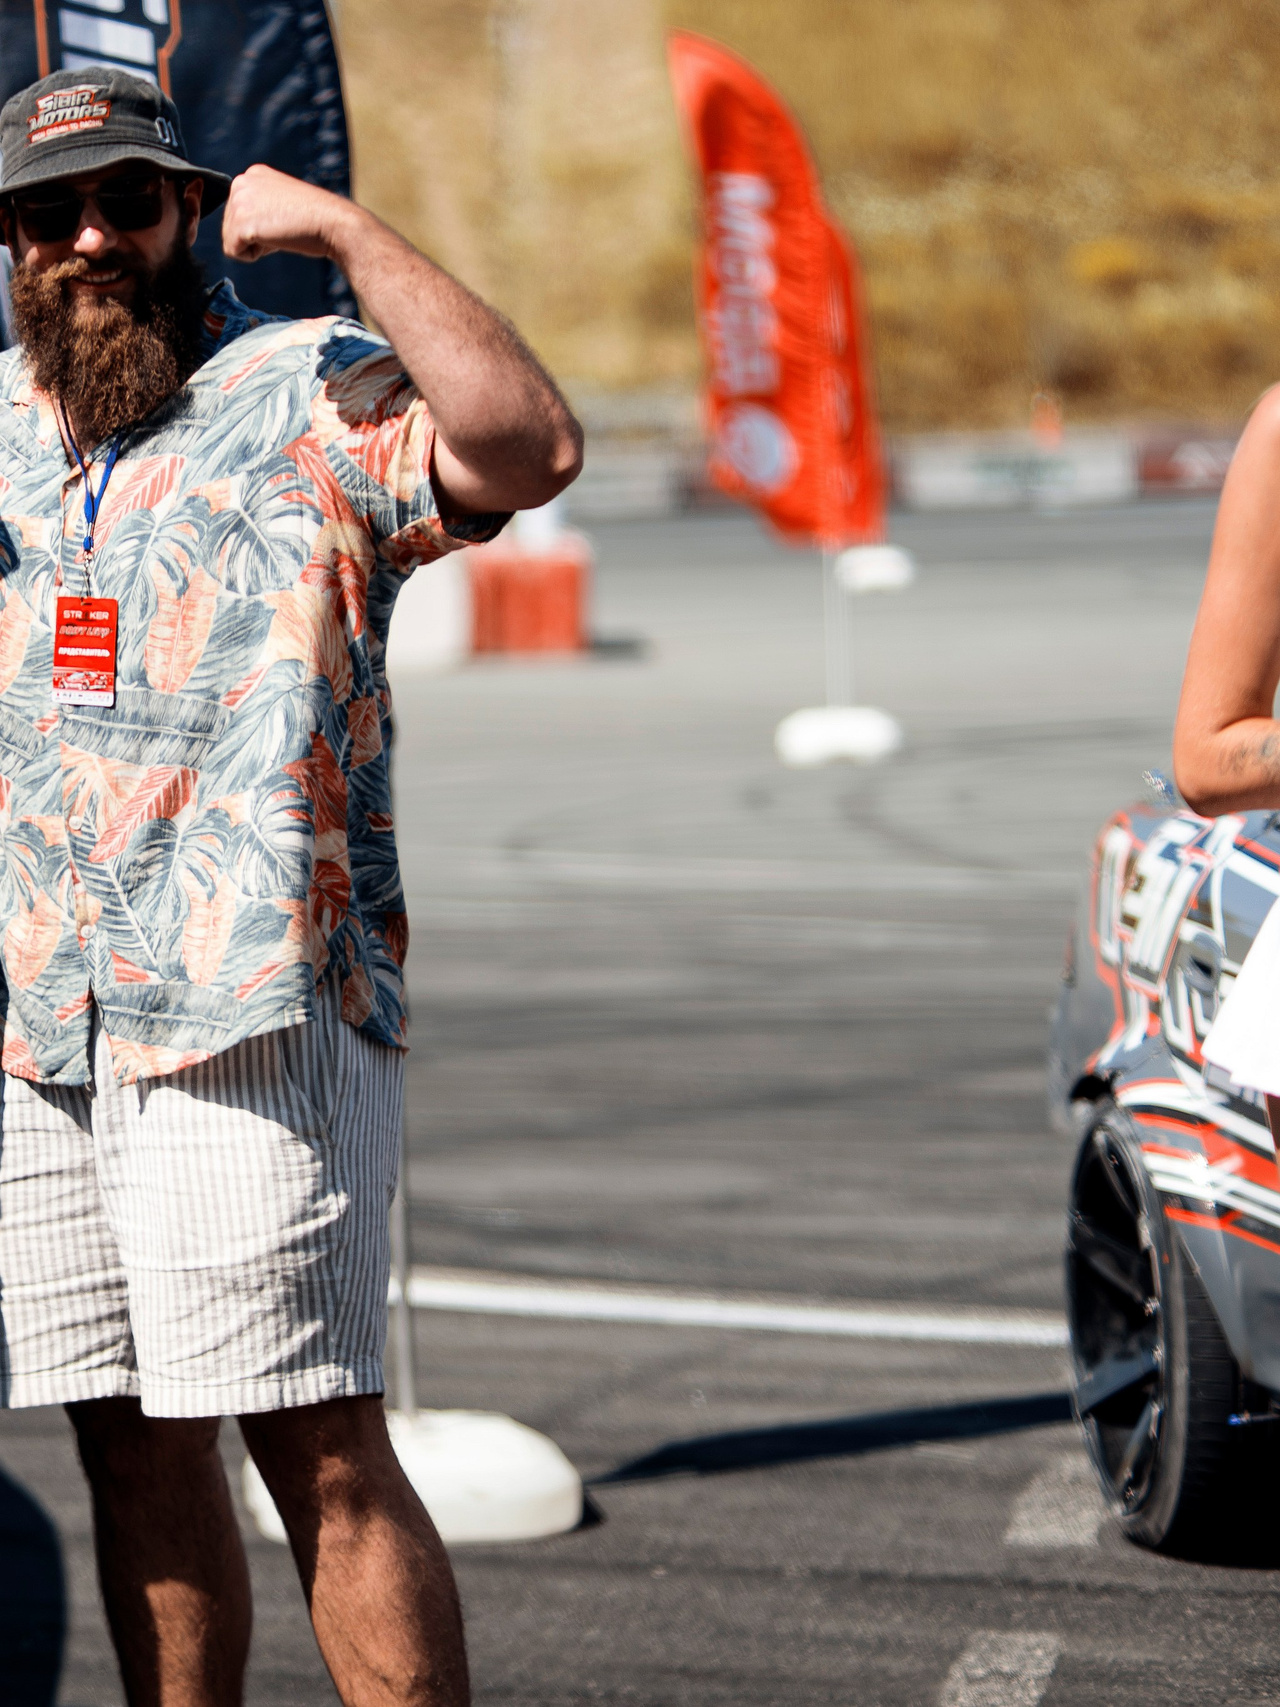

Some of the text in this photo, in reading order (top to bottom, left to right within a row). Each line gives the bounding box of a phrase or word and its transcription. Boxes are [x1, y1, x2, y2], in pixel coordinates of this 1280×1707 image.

[38, 91, 93, 113] SIBIR
[29, 102, 109, 131] MOTORS
[63, 610, 109, 620] STRKER
